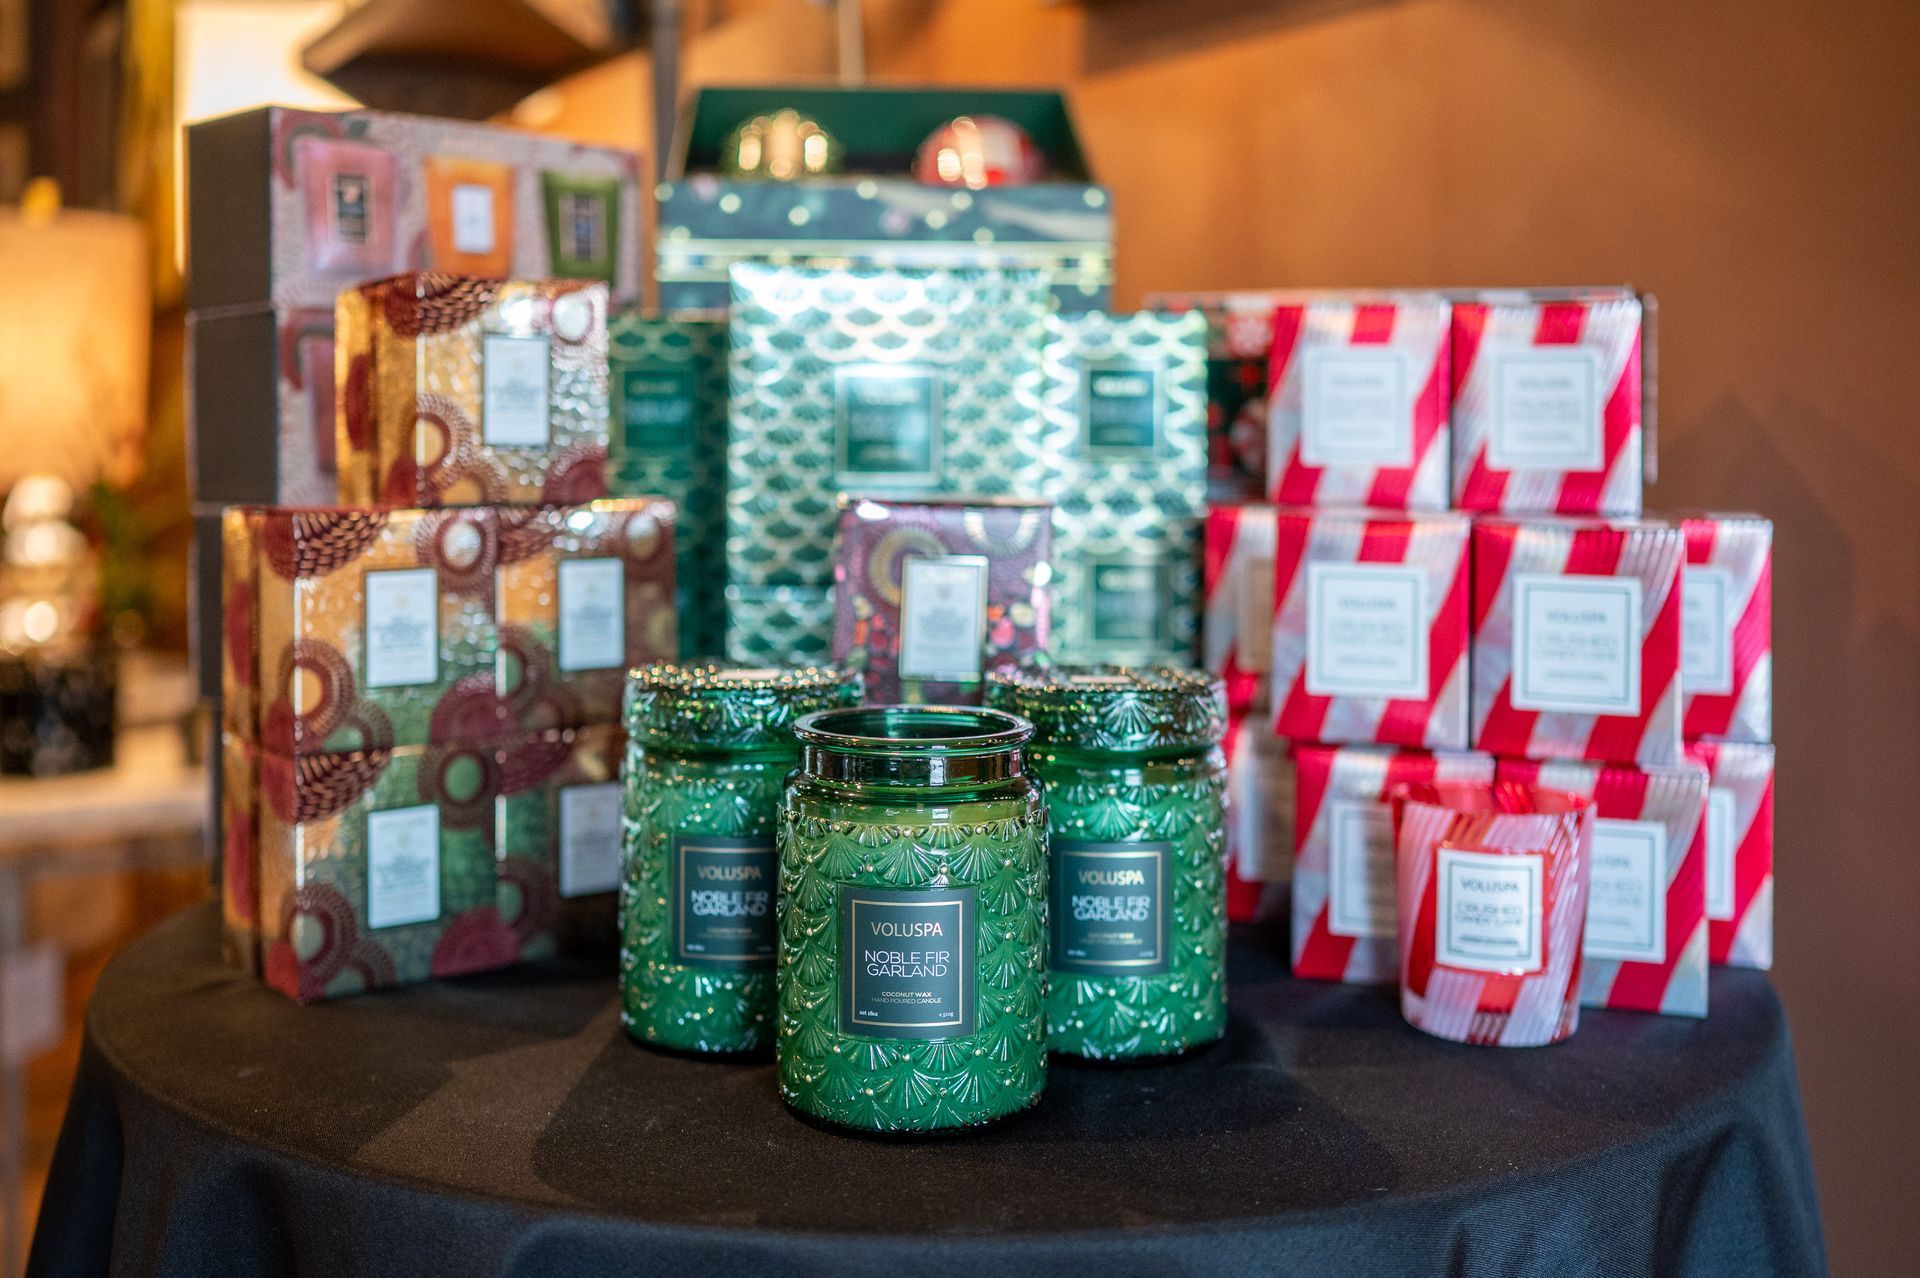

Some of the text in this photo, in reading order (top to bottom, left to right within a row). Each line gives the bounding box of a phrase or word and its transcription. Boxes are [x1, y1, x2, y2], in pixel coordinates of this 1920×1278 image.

[697, 865, 762, 880] VOLUSPA
[1078, 870, 1145, 885] VOLUSPA
[1460, 879, 1520, 893] VOLUSPA
[691, 890, 769, 903] NOBLE FIR
[1072, 895, 1151, 909] NOBLE FIR
[692, 902, 767, 916] GARLAND
[1074, 907, 1149, 921] GARLAND
[871, 922, 943, 937] VOLUSPA
[865, 950, 950, 965] NOBLE FIR
[867, 964, 948, 978] GARLAND
